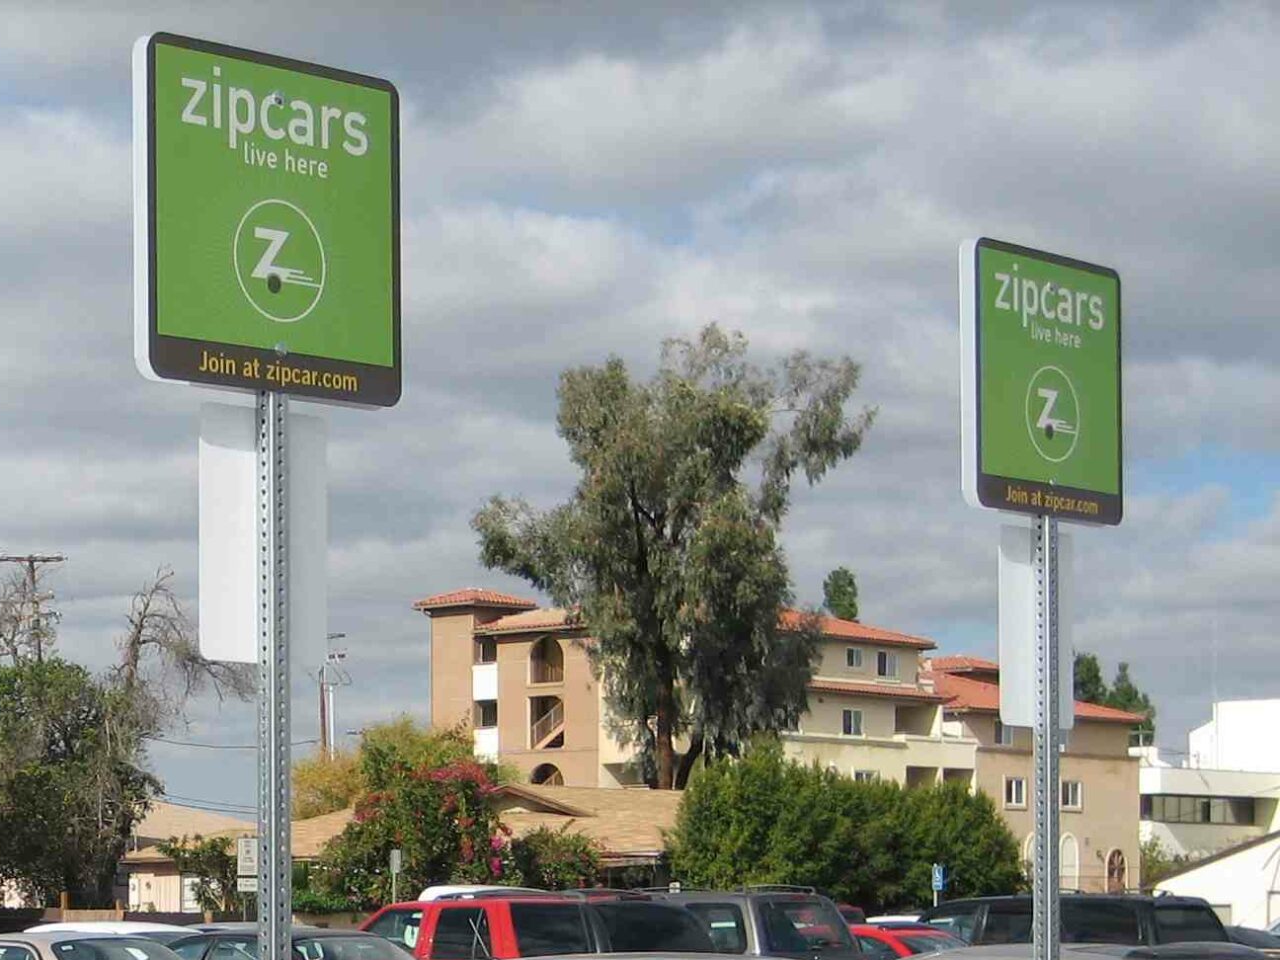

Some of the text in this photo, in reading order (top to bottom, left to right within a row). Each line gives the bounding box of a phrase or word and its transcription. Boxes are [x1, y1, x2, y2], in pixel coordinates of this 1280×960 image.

[181, 66, 369, 157] zipcars
[244, 142, 328, 179] live here
[994, 264, 1105, 331] zipcars
[1031, 321, 1082, 349] live here
[199, 351, 359, 392] Join at zipcar.com
[1005, 485, 1099, 515] Join at zipcar.com
